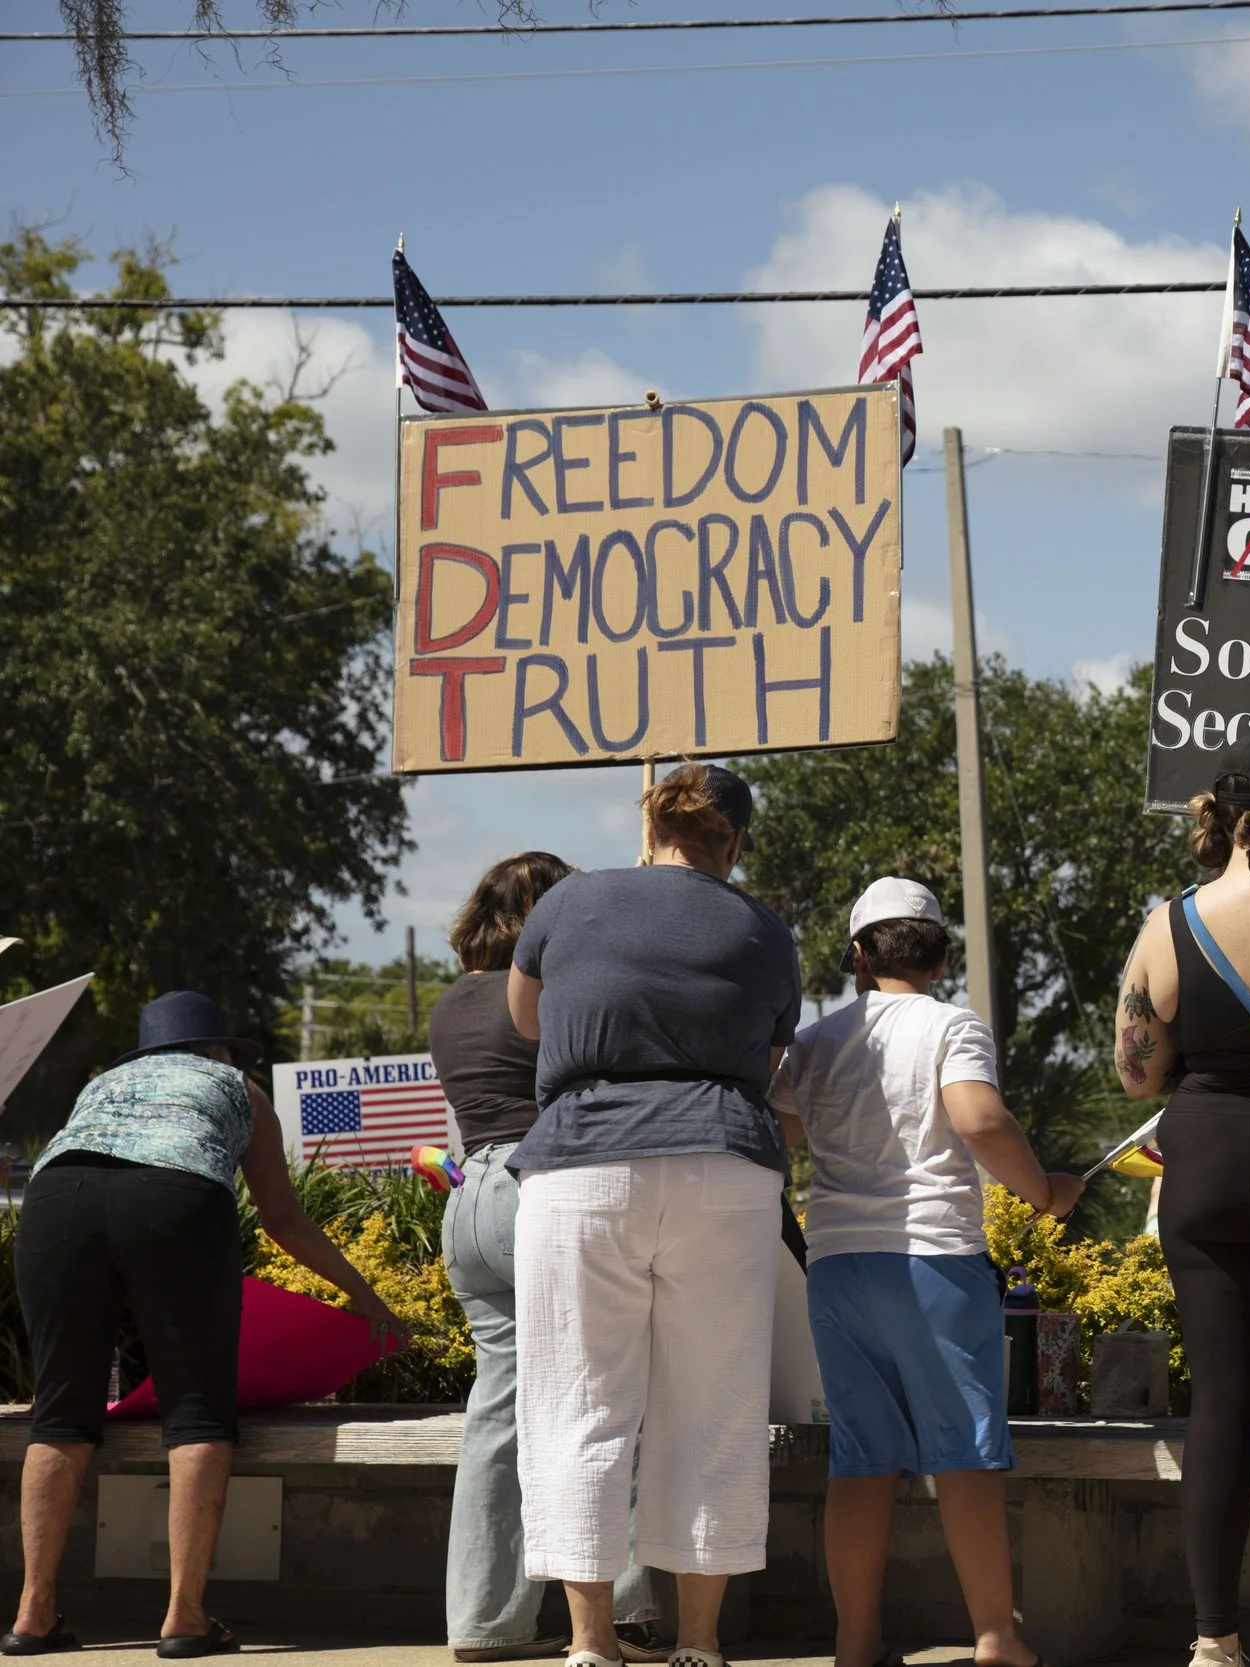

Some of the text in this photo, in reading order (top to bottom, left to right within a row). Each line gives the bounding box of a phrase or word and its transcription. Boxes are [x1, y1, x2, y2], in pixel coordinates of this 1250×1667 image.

[420, 397, 867, 531] FREEDOM
[414, 498, 892, 654] DEMOCRACY
[409, 627, 832, 762] TRUTH
